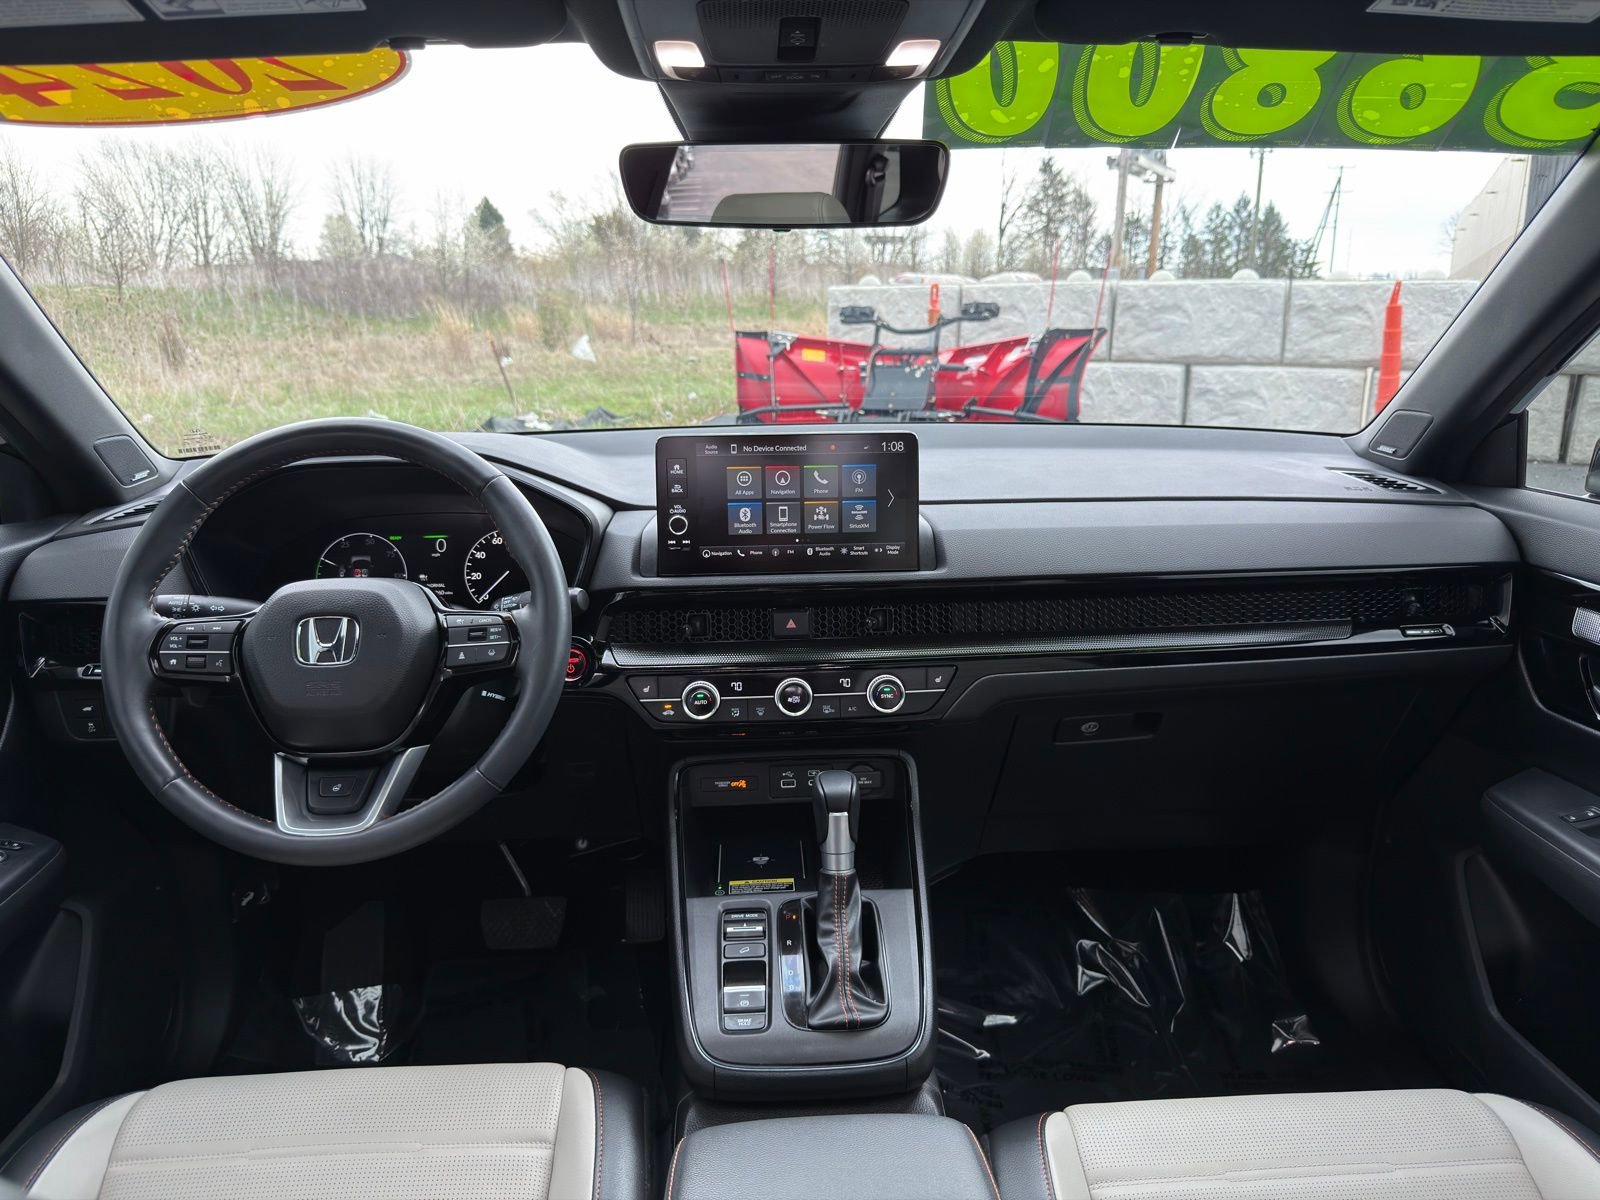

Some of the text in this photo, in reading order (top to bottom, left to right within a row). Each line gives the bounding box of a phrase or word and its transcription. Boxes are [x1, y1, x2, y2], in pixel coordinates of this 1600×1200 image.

[881, 441, 904, 452] 1:08
[435, 538, 447, 553] 0
[491, 537, 503, 545] 60
[475, 551, 486, 559] 40
[470, 572, 482, 580] 20
[730, 681, 743, 692] 70
[839, 678, 851, 688] 70
